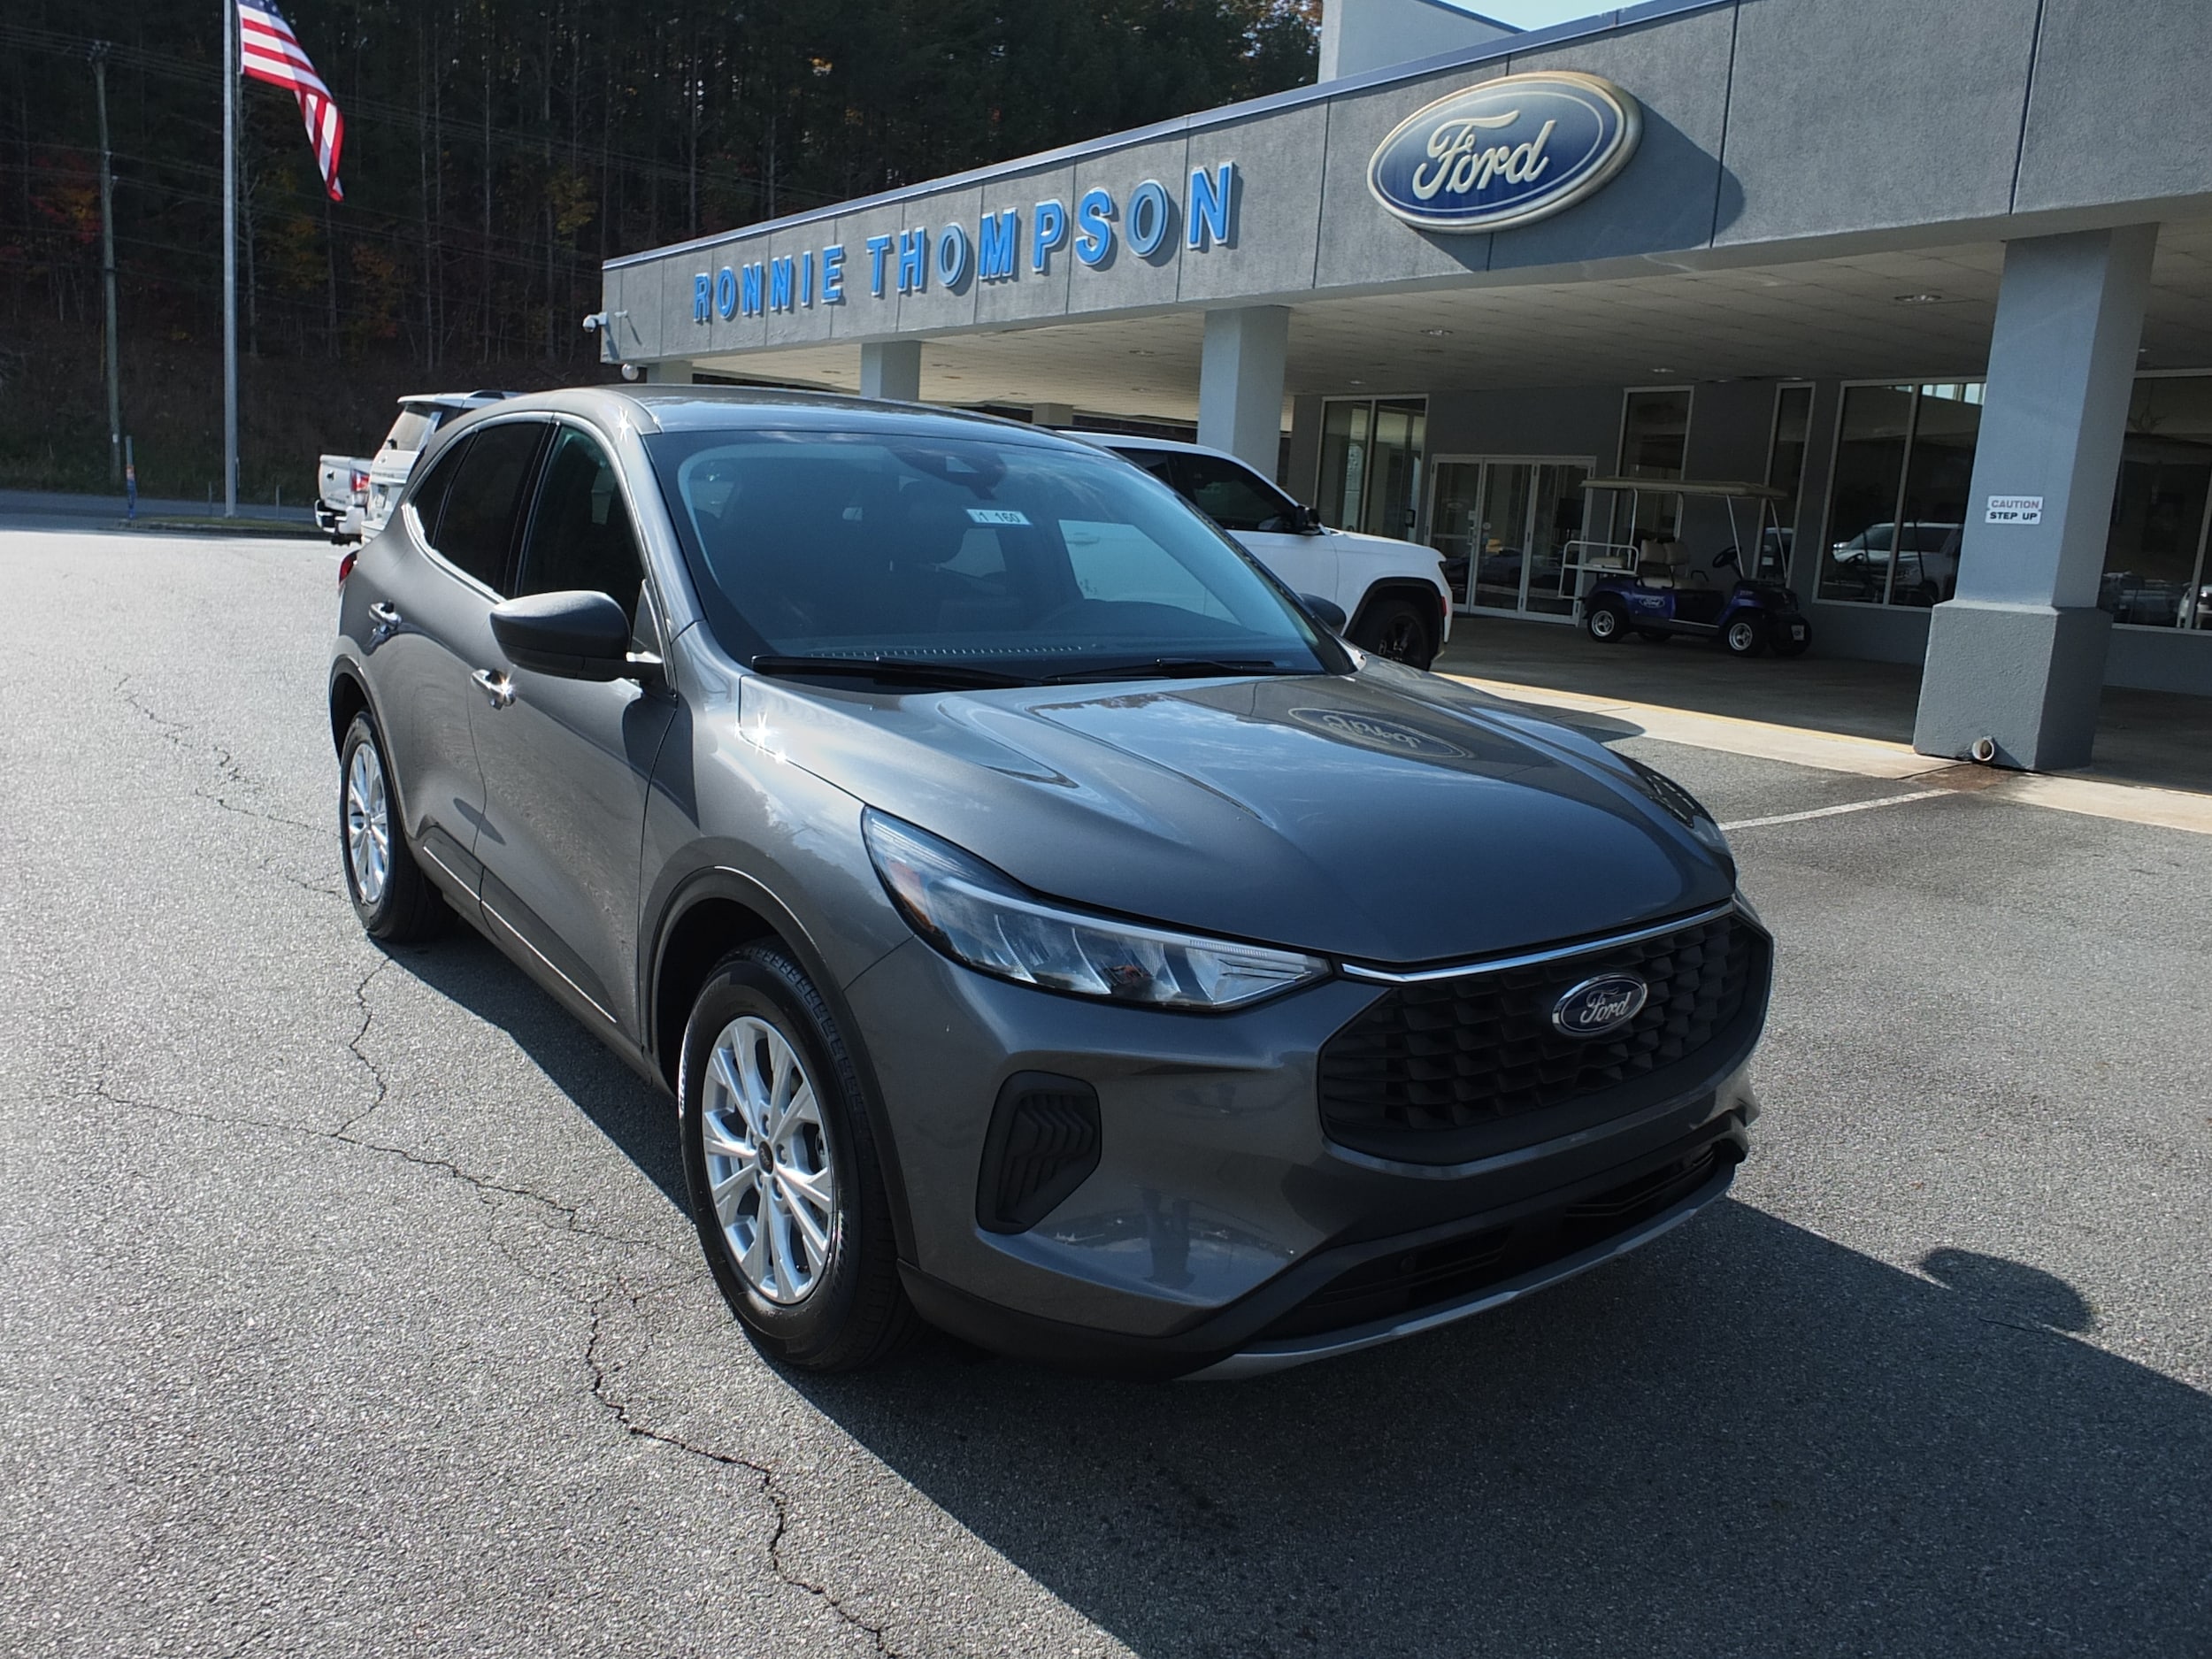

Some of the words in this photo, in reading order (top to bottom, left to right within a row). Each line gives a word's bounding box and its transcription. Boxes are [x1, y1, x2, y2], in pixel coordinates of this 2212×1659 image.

[1412, 110, 1557, 200] Ford
[694, 243, 845, 324] RONNIE
[866, 160, 1235, 298] THOMPSON
[1989, 511, 2018, 520] STEP
[1991, 500, 2039, 509] CAUTION
[1579, 987, 1632, 1024] Ford
